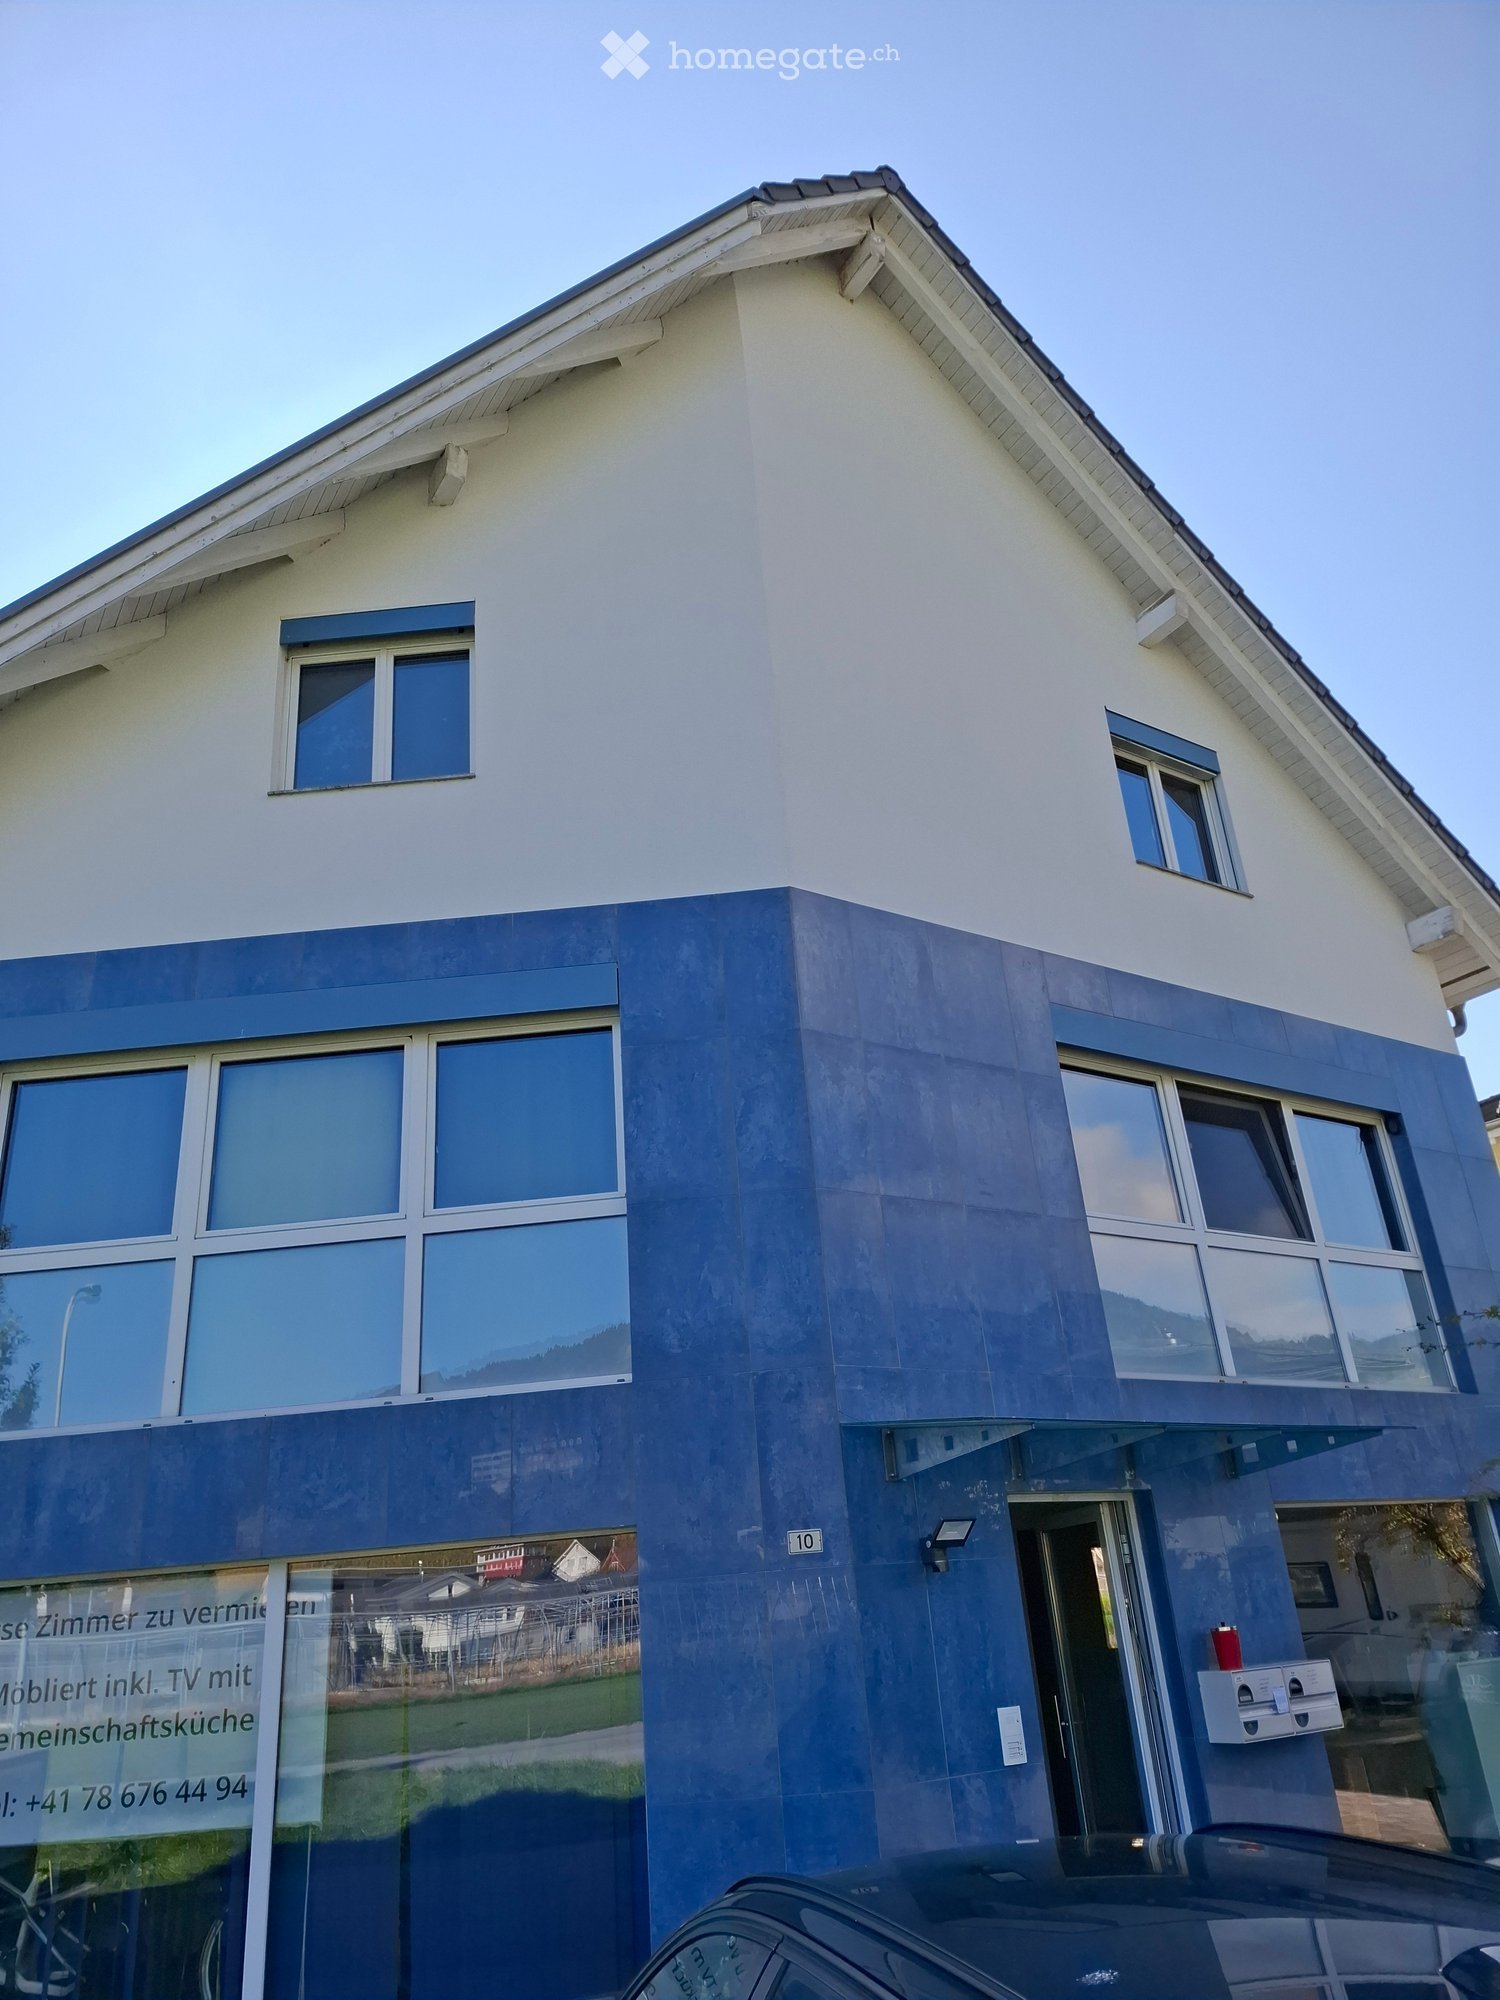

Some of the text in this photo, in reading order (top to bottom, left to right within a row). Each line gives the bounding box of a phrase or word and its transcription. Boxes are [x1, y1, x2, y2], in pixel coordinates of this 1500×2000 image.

[796, 1533, 814, 1550] 10
[0, 1596, 316, 1641] se Zimmer zu vermieen
[104, 1670, 159, 1698] inkl.
[168, 1667, 202, 1692] TV
[208, 1663, 253, 1689] mit
[0, 1774, 248, 1818] l: +41 78 676 44 94
